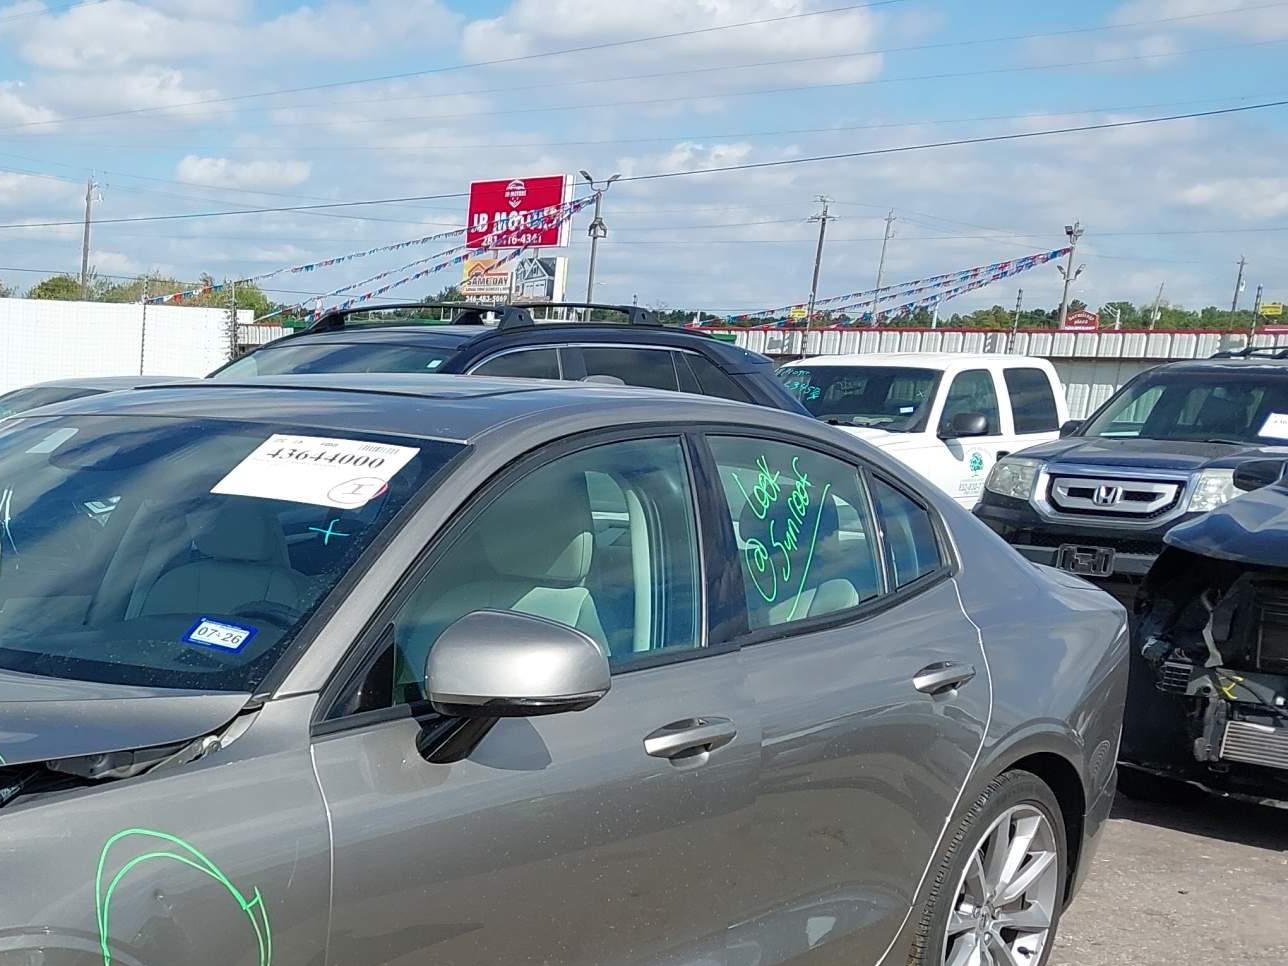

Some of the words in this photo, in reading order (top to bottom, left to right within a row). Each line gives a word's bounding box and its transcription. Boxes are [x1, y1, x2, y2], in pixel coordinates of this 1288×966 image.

[470, 212, 489, 233] JB
[492, 276, 509, 286] DAY
[266, 447, 385, 469] 43644000
[197, 626, 218, 638] 07
[220, 632, 243, 645] 26
